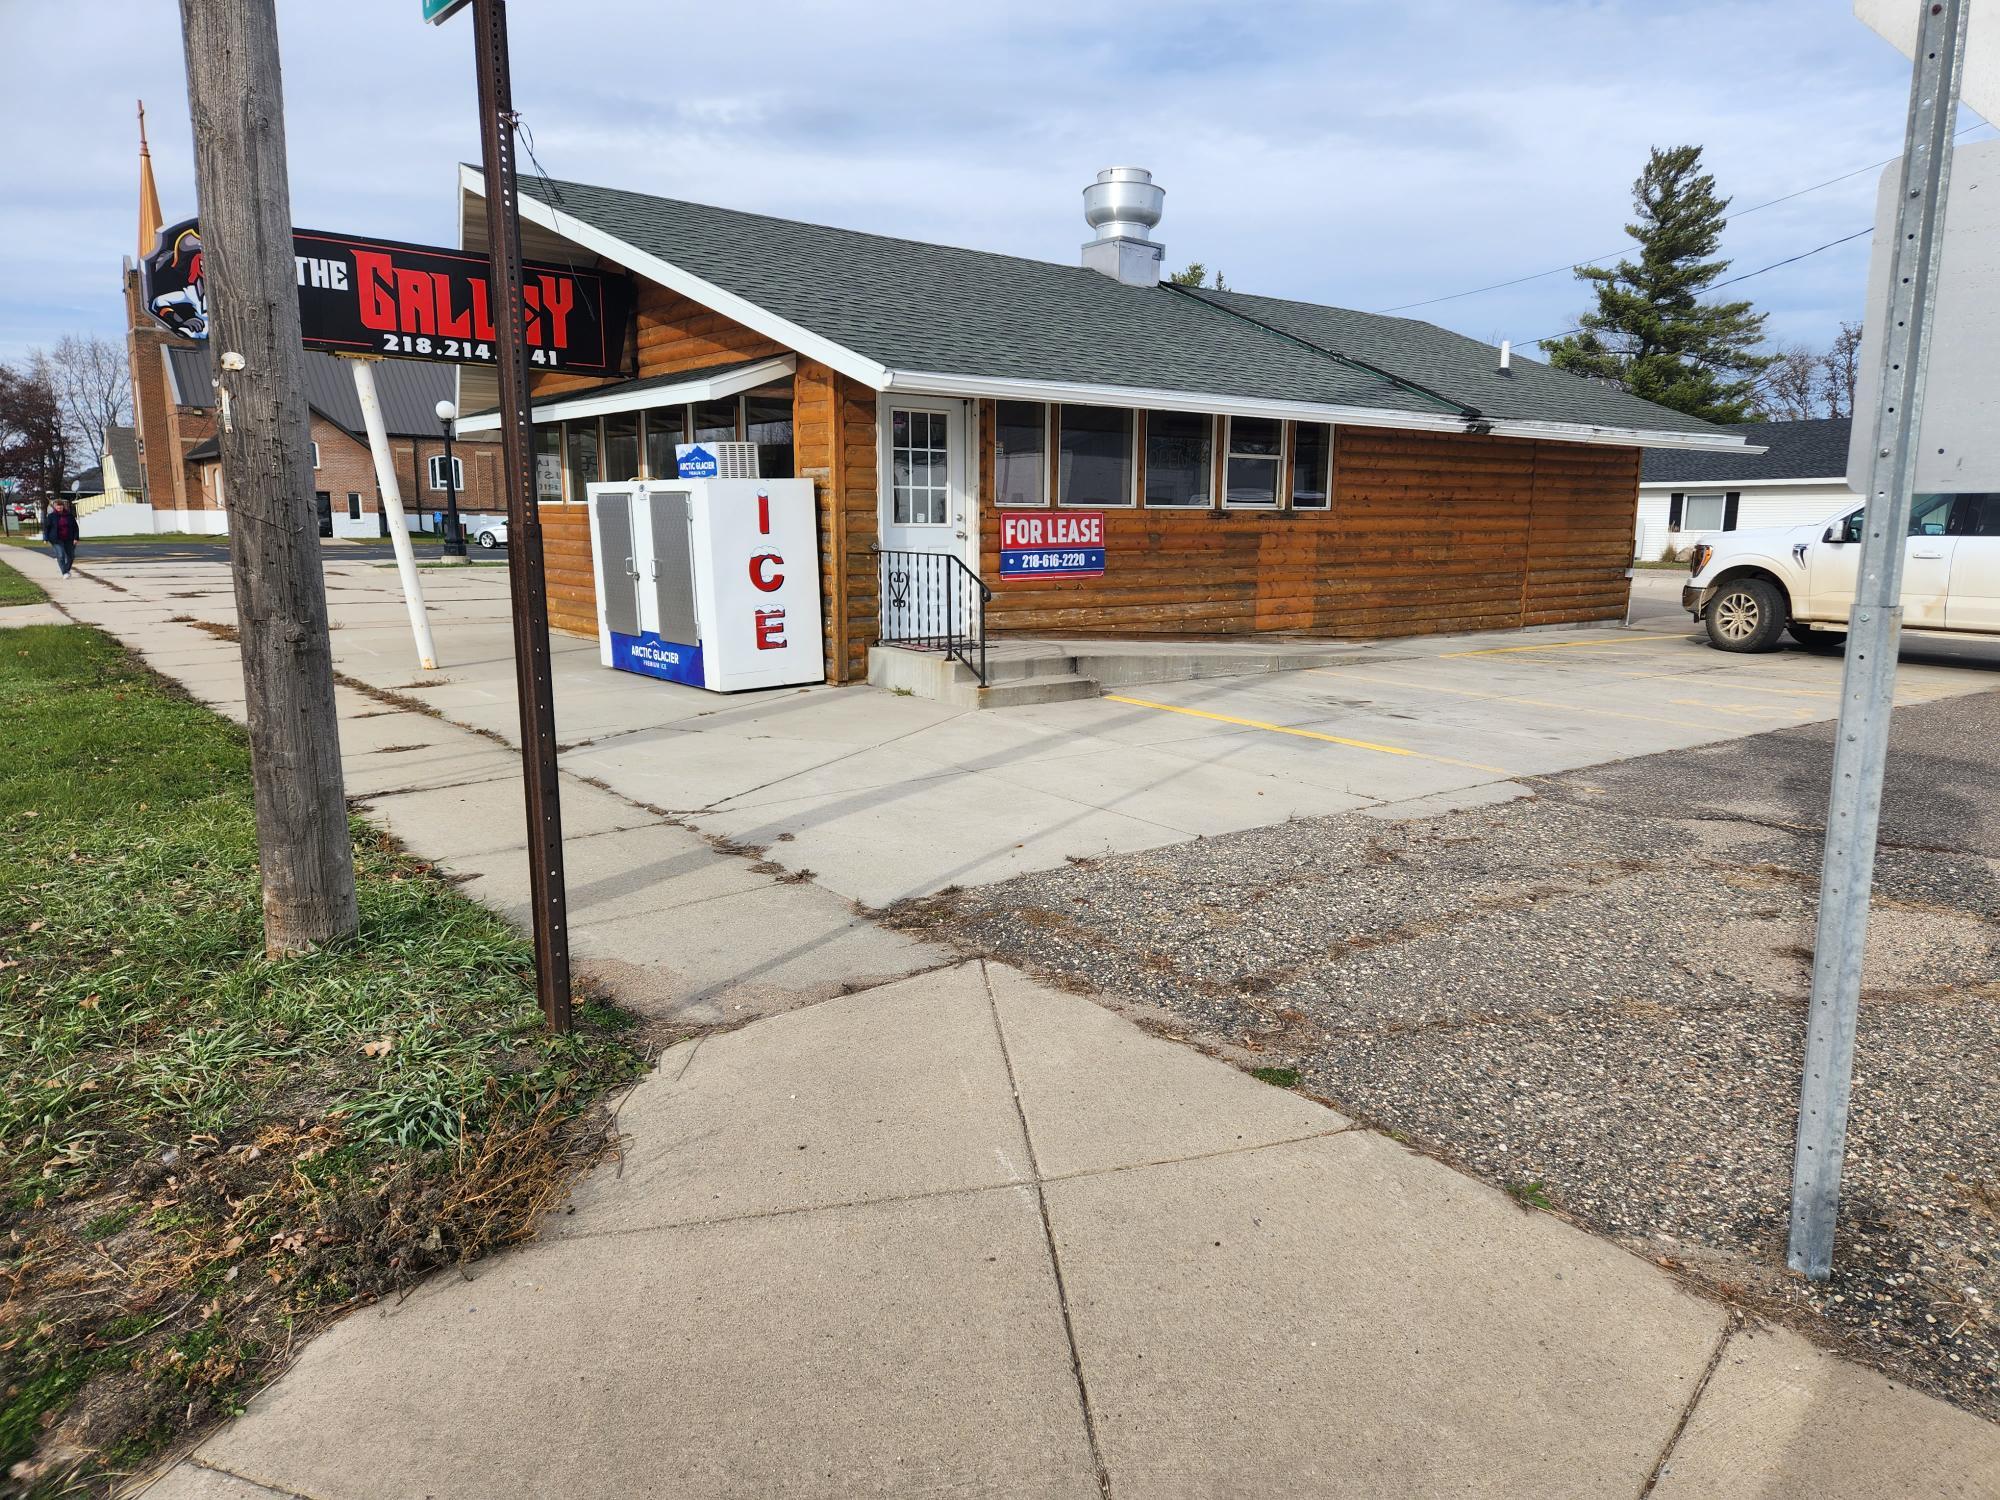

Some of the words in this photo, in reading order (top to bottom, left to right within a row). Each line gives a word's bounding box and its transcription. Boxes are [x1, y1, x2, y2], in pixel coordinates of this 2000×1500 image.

[295, 256, 348, 290] THE
[679, 462, 696, 471] ARCTIC
[696, 461, 715, 470] GLACIER
[1005, 519, 1043, 544] FOR
[1047, 518, 1100, 543] LEASE
[749, 488, 788, 650] ICE
[1022, 553, 1085, 568] 218-616-2220
[631, 645, 652, 659] ARCTIC
[653, 649, 679, 664] GLACIER
